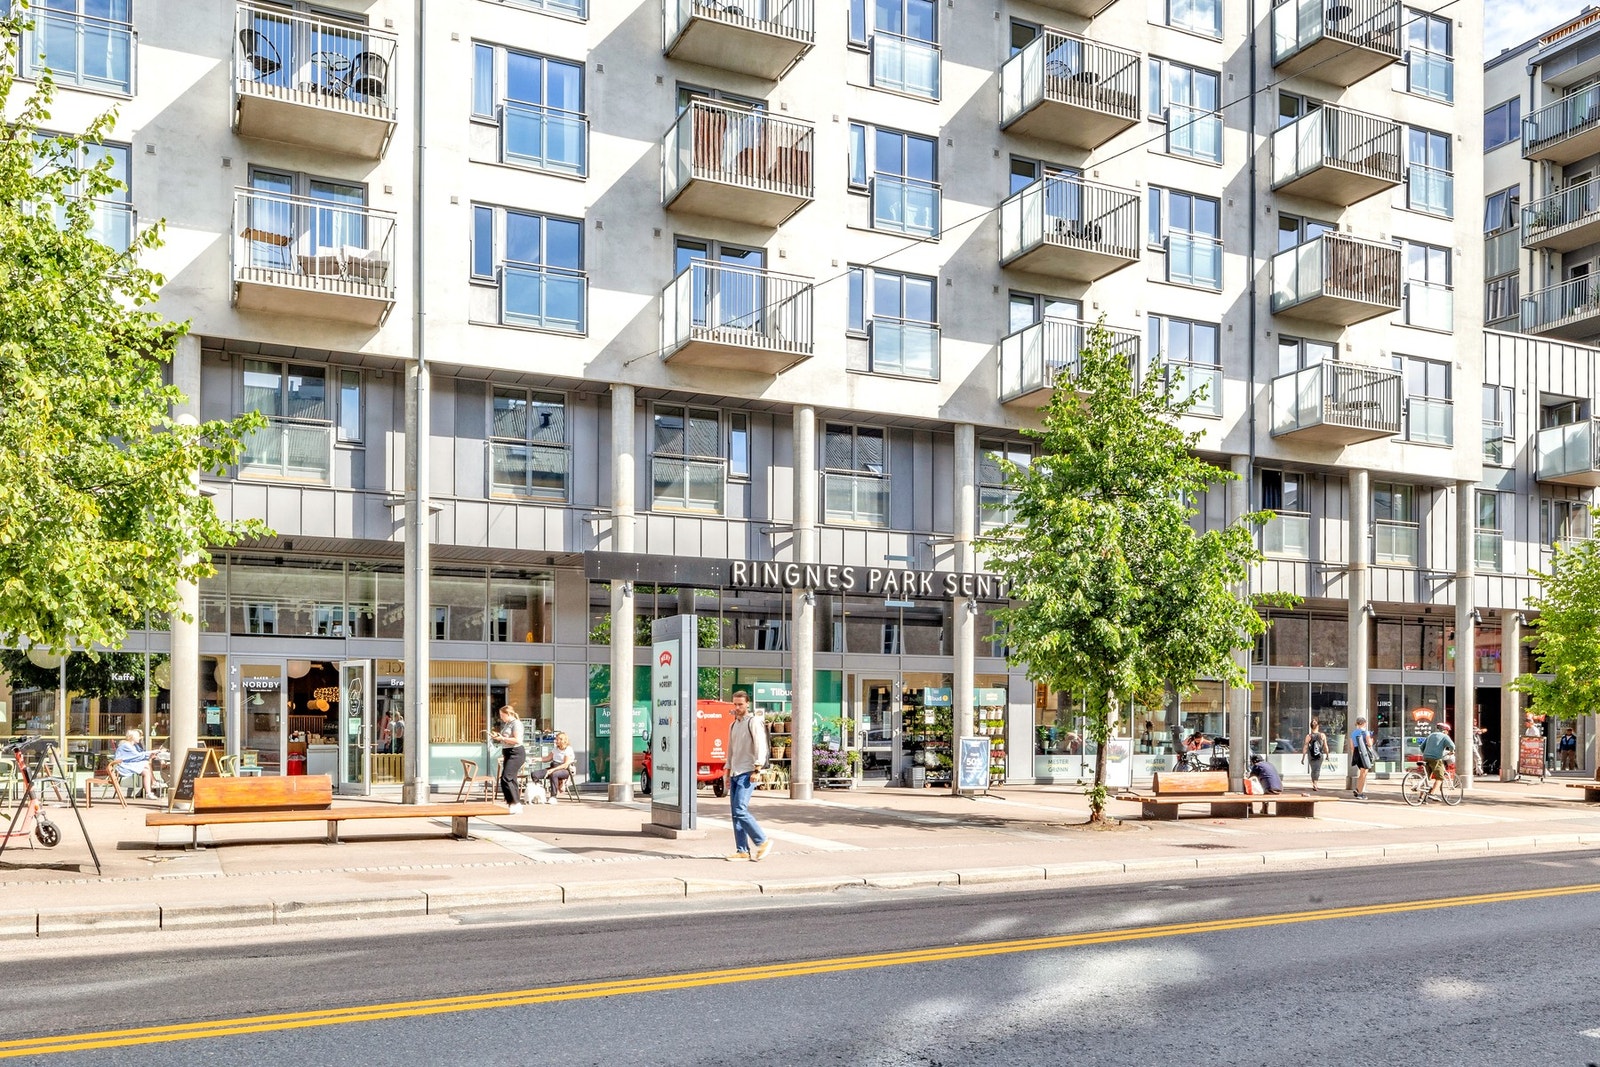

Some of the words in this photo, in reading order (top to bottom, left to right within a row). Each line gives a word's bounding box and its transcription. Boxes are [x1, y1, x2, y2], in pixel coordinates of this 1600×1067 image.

[732, 561, 855, 589] RINGNES
[869, 569, 933, 593] PARK
[945, 573, 1006, 598] SENT
[770, 687, 793, 697] Tilbu
